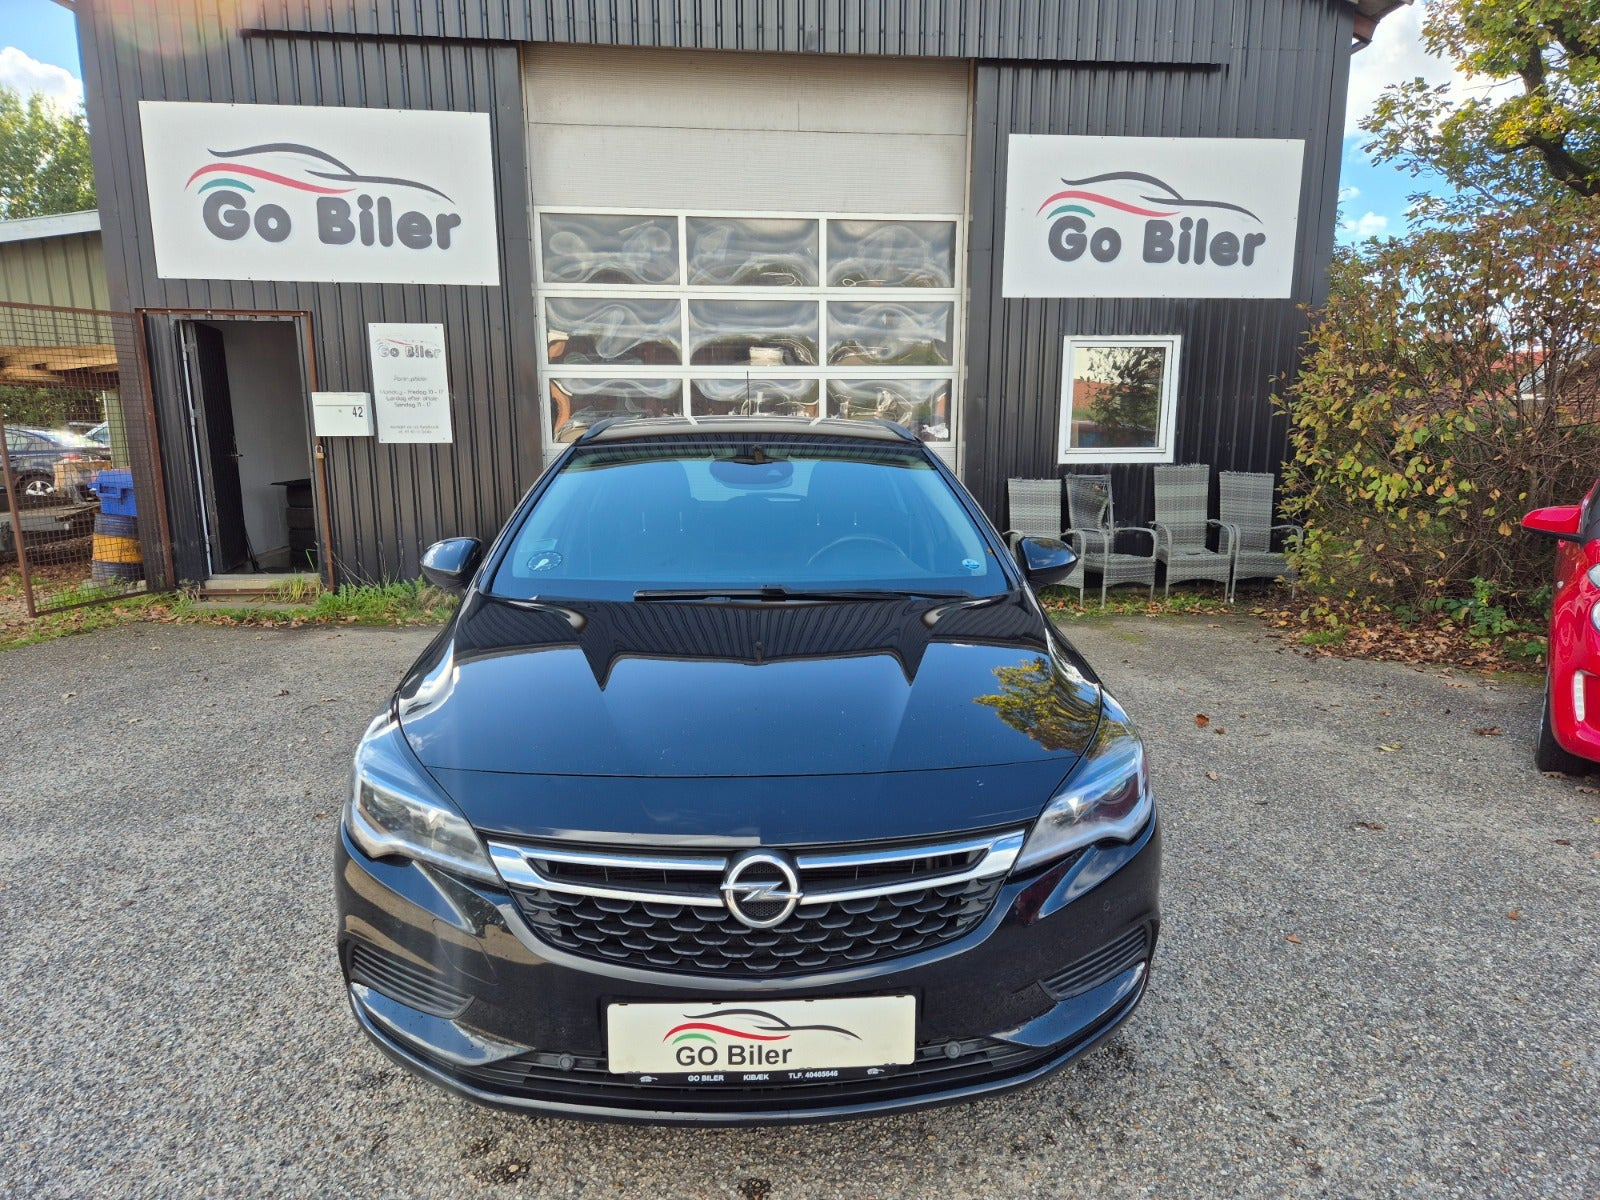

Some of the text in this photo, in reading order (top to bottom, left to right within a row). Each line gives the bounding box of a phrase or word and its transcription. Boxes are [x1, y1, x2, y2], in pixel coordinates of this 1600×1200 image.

[203, 190, 461, 250] Go Biler
[1048, 215, 1266, 267] Go Biler
[405, 345, 441, 358] Biler
[352, 406, 363, 418] 42
[675, 1044, 792, 1067] GO Biler
[687, 1074, 701, 1083] GO
[702, 1074, 725, 1083] BILER
[743, 1073, 769, 1081] KIBÆK
